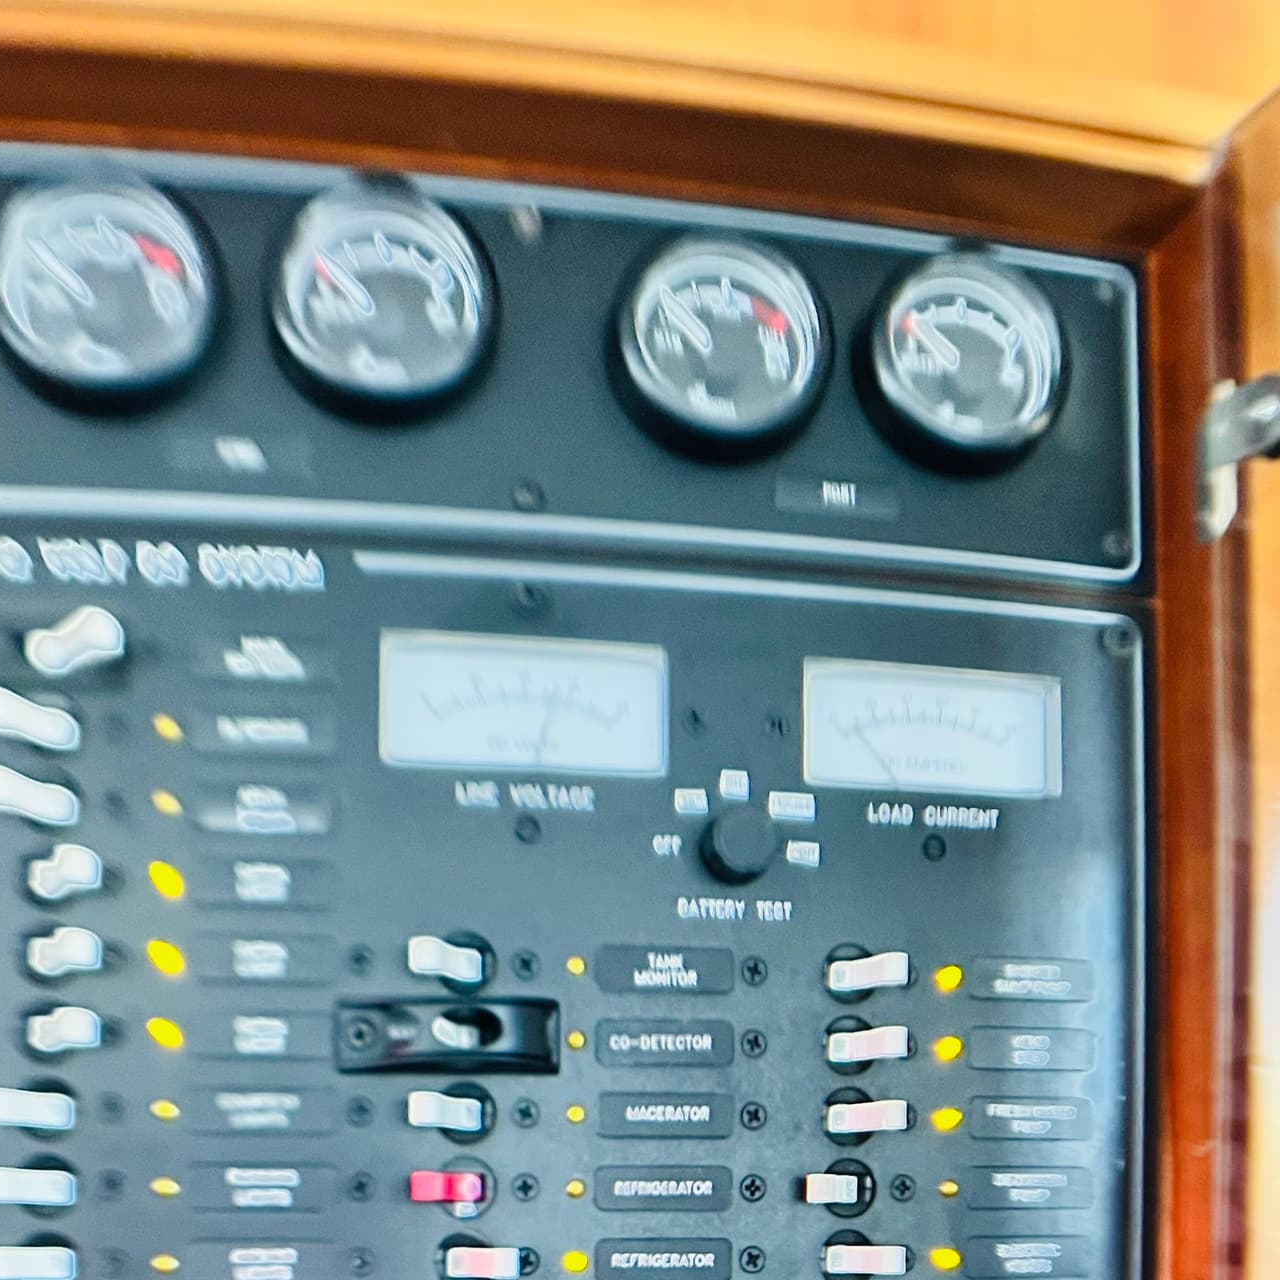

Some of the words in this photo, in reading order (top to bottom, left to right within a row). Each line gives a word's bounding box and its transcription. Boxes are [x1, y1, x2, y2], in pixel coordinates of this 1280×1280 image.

[868, 801, 914, 825] LOAD
[923, 804, 1000, 830] CURRENT
[677, 897, 745, 920] BATTERY
[756, 900, 792, 921] TEST
[647, 952, 683, 969] TANK
[634, 968, 698, 988] MONITOR
[609, 1033, 712, 1052] CO-DETECTOR
[626, 1104, 710, 1122] MACERATOR
[614, 1180, 713, 1196] REFRIGERATOR
[610, 1252, 715, 1269] REFRIGERATOR
